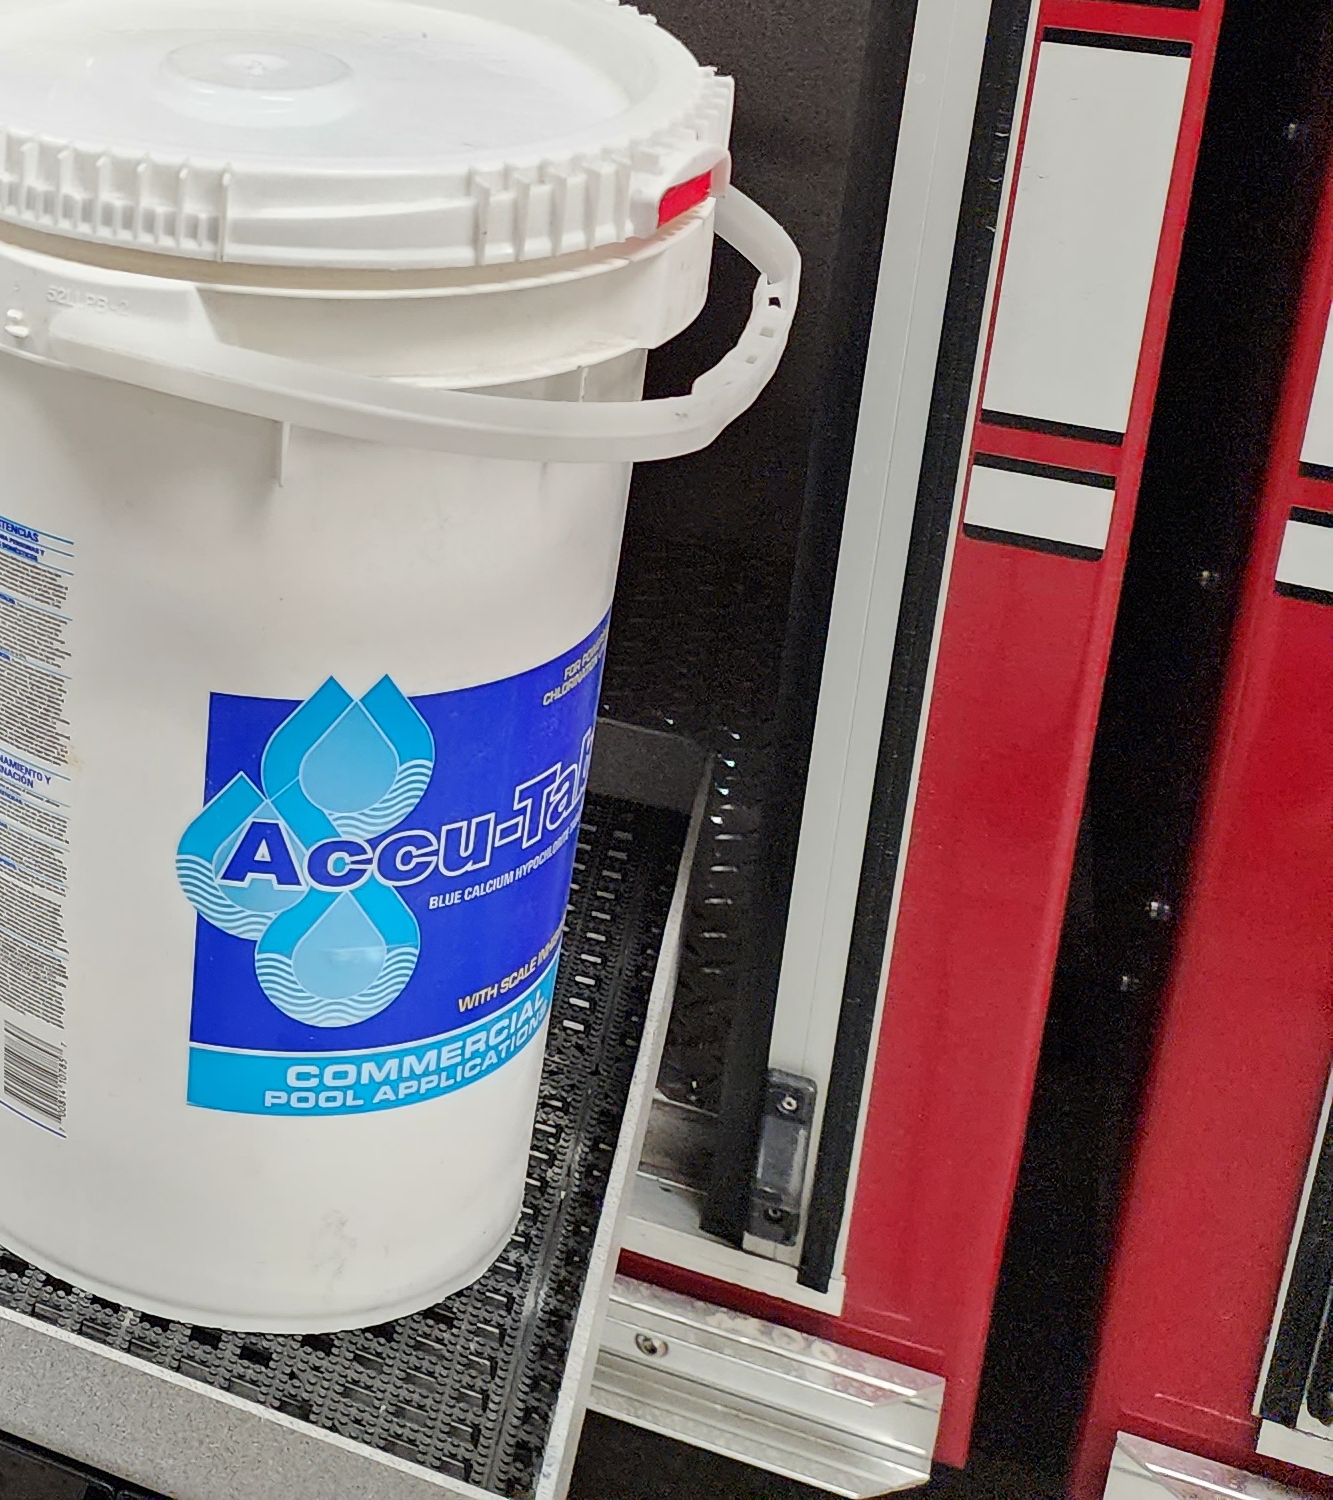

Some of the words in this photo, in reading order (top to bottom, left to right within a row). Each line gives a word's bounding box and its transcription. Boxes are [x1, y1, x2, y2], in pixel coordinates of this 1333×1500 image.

[563, 659, 581, 681] FOR
[44, 775, 52, 786] Y
[429, 889, 463, 910] BLUE
[464, 869, 515, 901] CALCIUM
[515, 834, 569, 881] HYPOCHLORITE
[458, 983, 498, 1013] WITH
[500, 956, 538, 995] SCALE
[264, 1090, 364, 1109] POOL
[372, 1001, 549, 1105] APPLICATIONS
[287, 989, 546, 1088] COMMERCIAL
